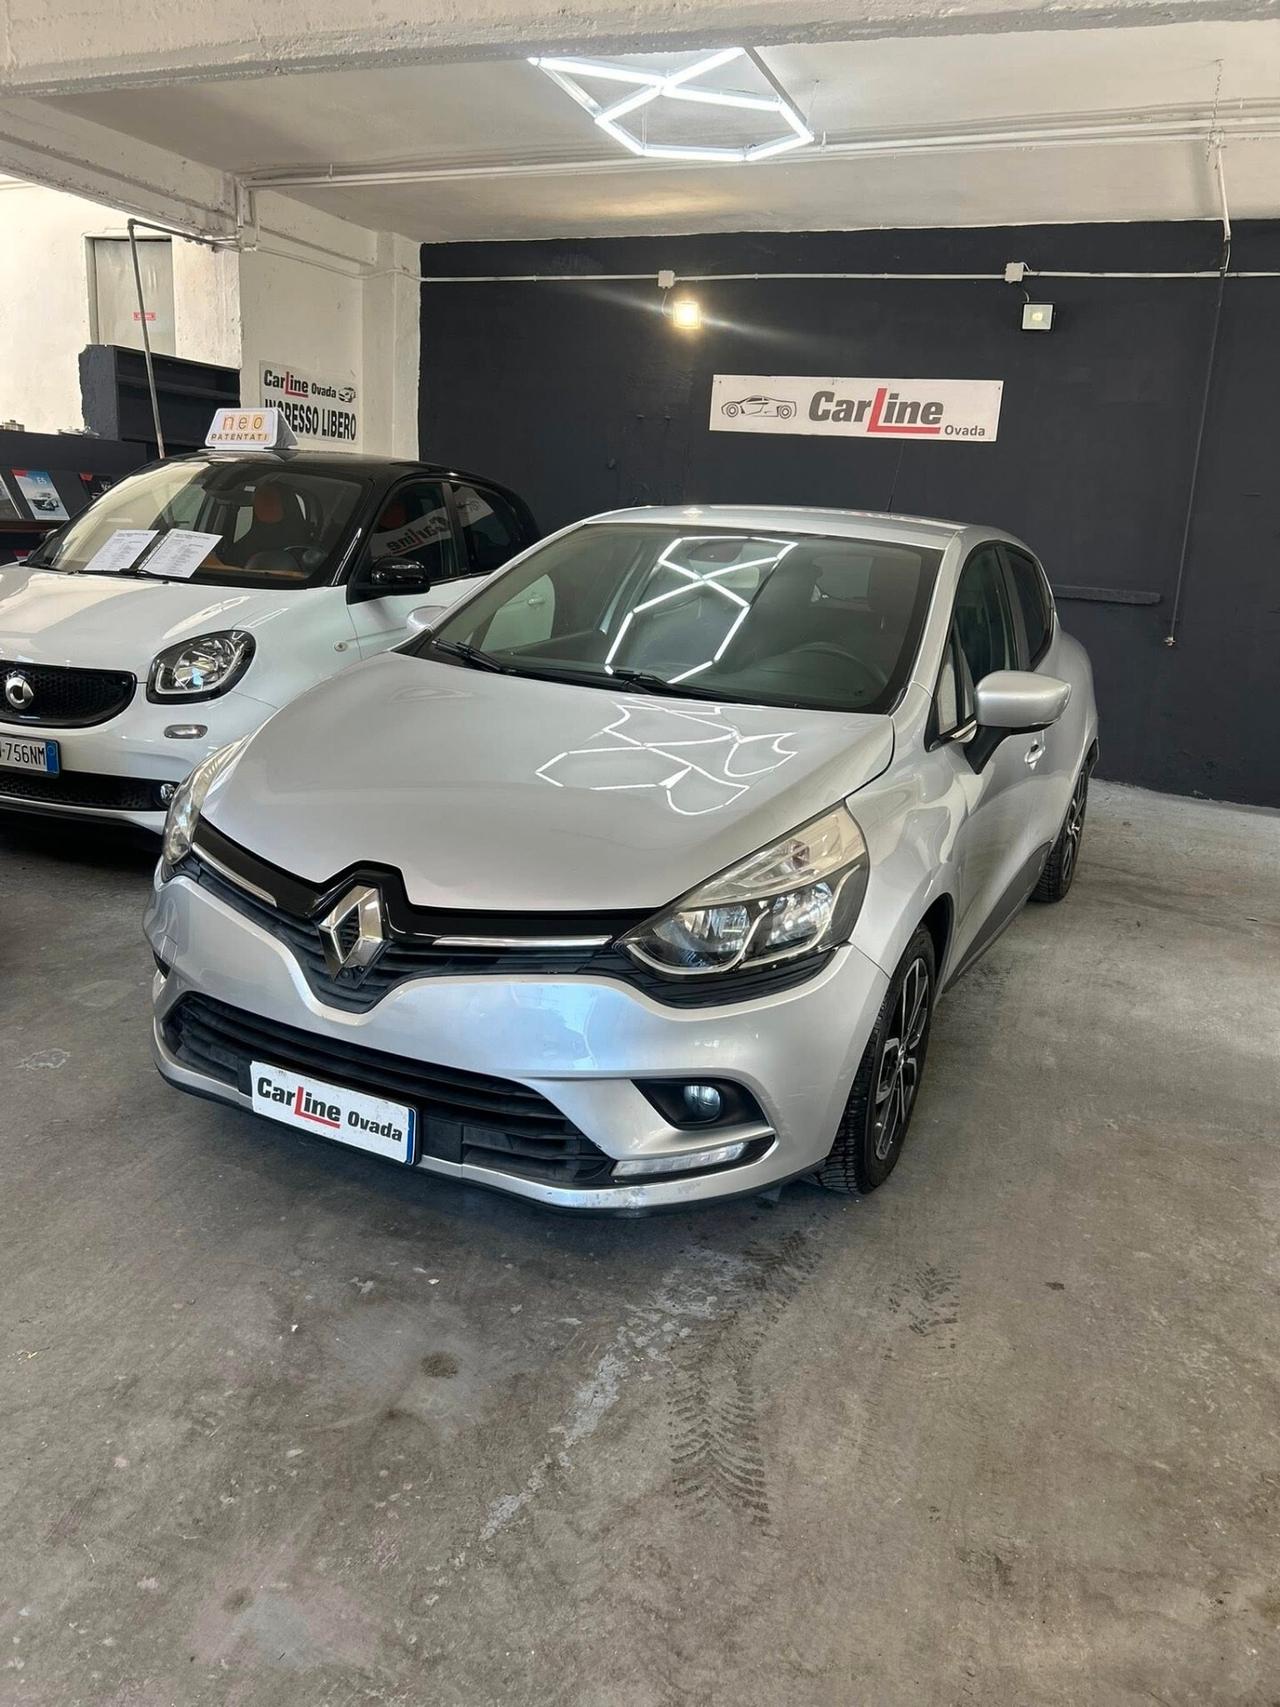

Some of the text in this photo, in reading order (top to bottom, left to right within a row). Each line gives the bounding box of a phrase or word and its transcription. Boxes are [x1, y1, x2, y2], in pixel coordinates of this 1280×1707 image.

[263, 369, 337, 398] CarLine Ovada
[222, 416, 263, 431] neo
[321, 408, 357, 441] LIBERO
[808, 387, 986, 437] CarLine Ovada
[210, 433, 268, 441] PATENTATI
[0, 741, 46, 766] 756NM
[257, 1077, 403, 1142] CarLine Ovada
